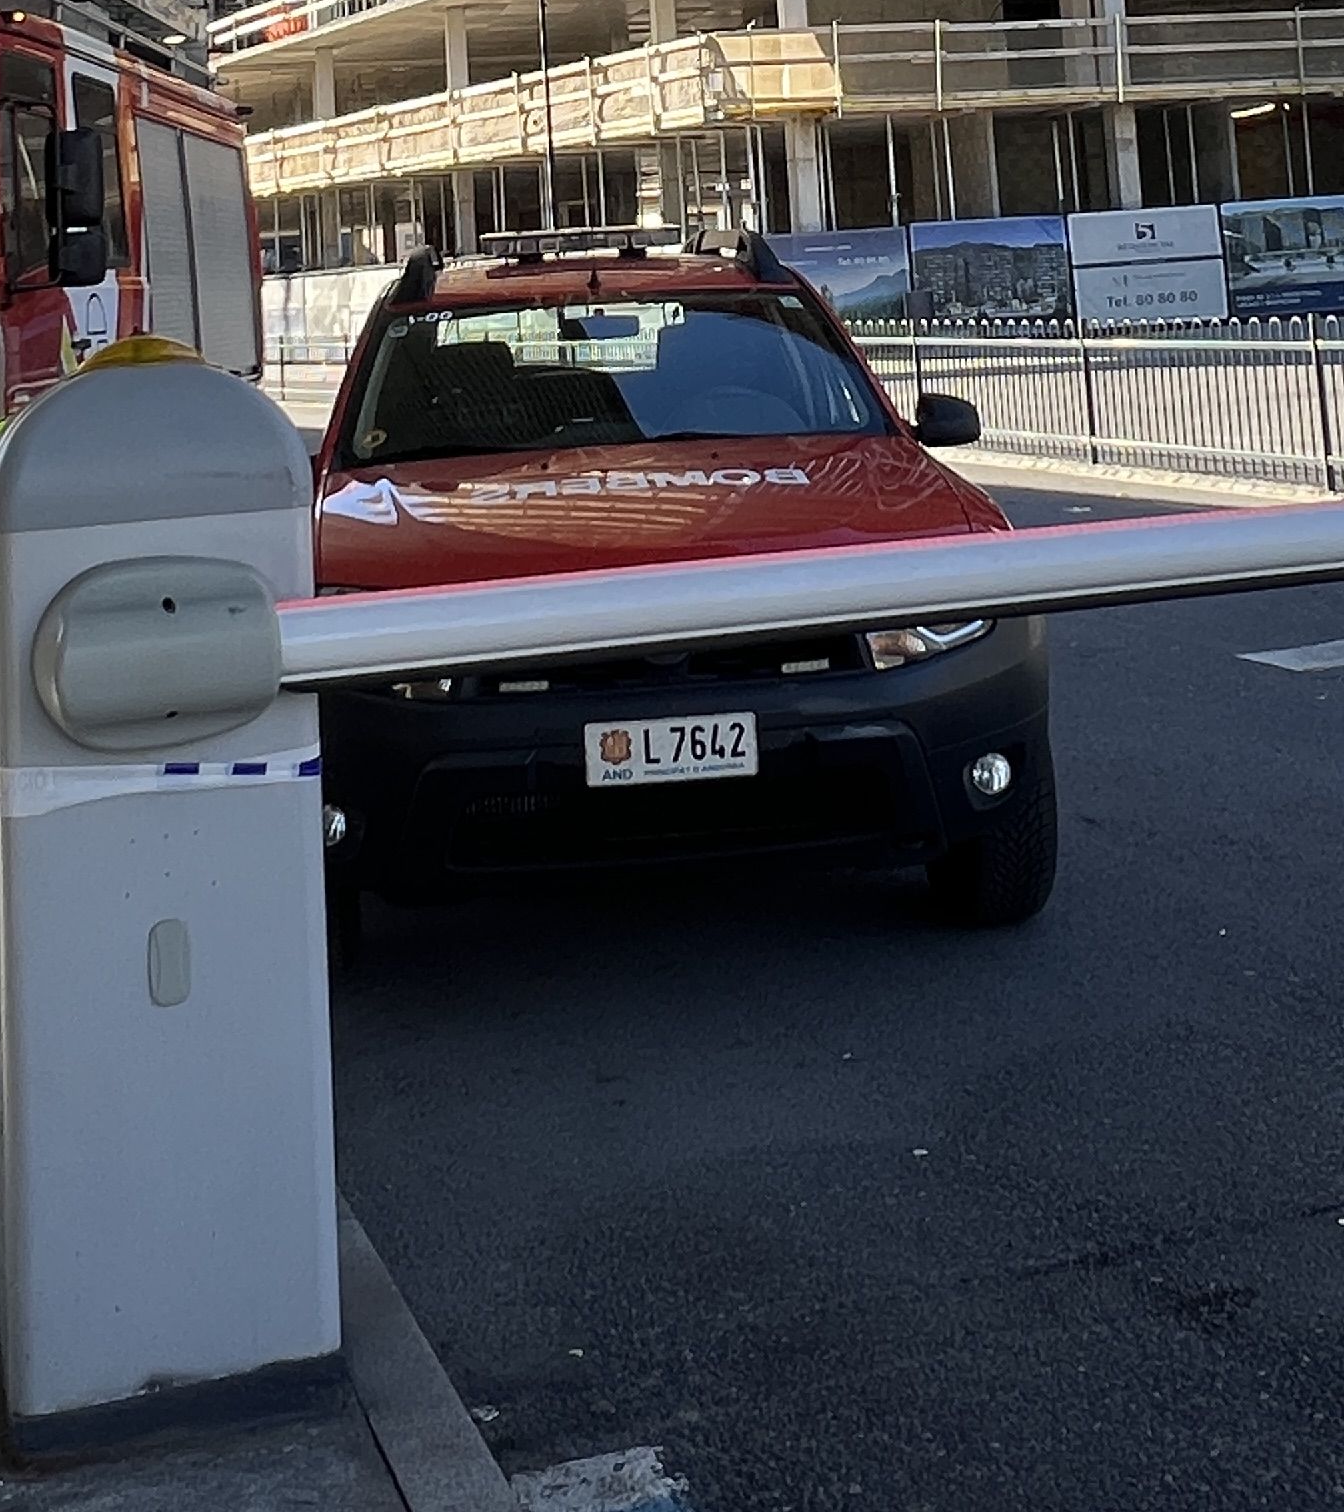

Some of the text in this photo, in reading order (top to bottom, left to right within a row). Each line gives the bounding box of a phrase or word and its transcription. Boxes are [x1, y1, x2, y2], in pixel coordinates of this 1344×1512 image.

[1107, 290, 1198, 308] Tel. 80 80 80
[643, 722, 746, 764] L 7642
[601, 768, 634, 782] AND
